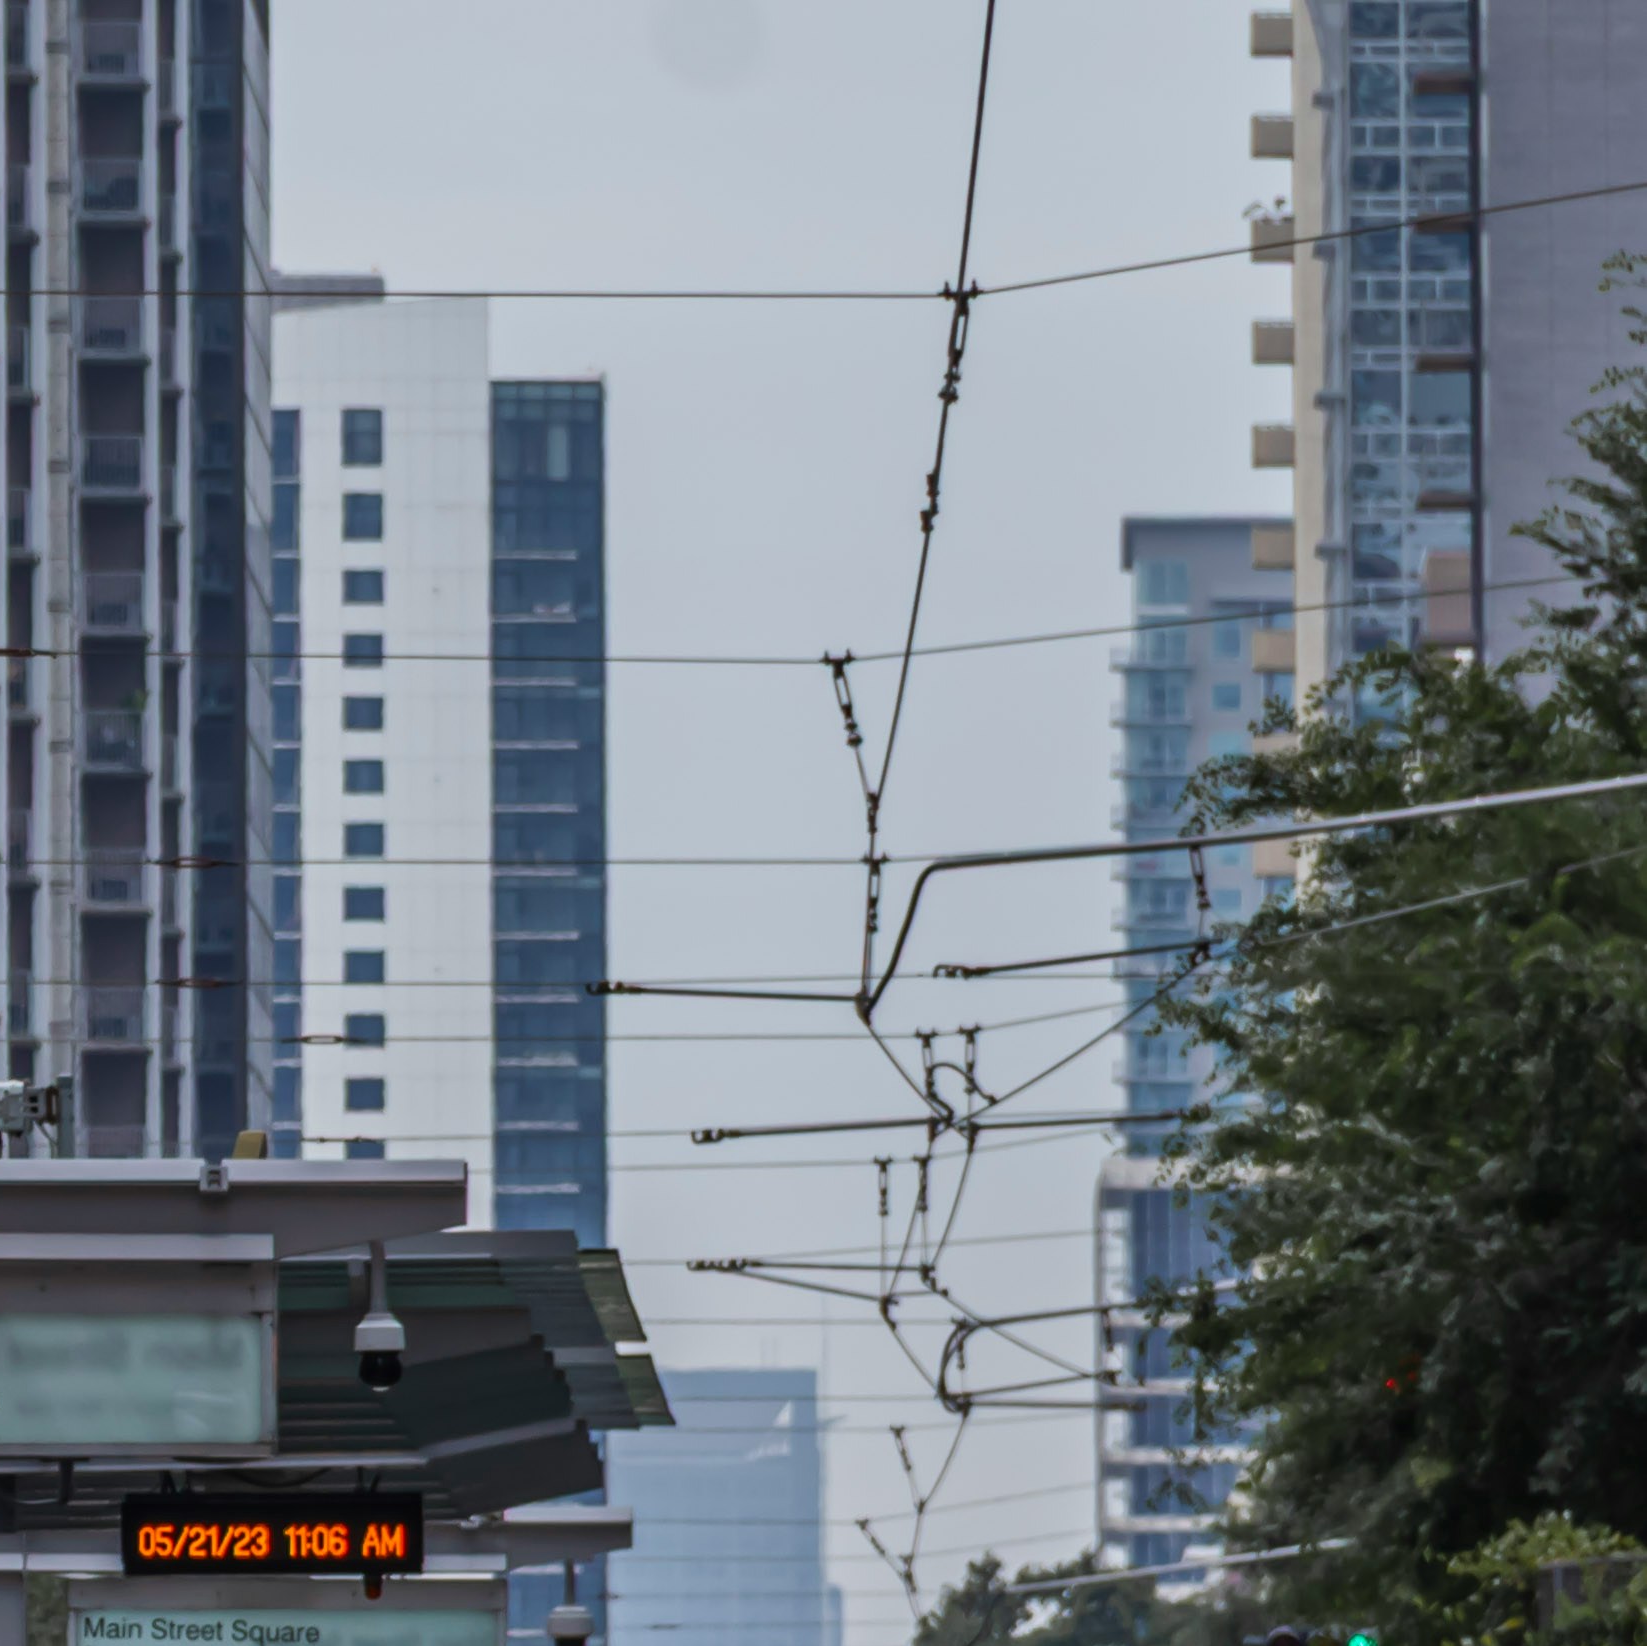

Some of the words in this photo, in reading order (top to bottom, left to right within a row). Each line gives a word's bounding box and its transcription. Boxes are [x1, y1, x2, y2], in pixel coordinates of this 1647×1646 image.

[138, 1524, 270, 1558] 05/21/23
[283, 1524, 349, 1558] 11:06
[362, 1524, 406, 1558] AM
[84, 1617, 142, 1640] Main
[151, 1617, 224, 1641] Street
[231, 1619, 320, 1646] Square
